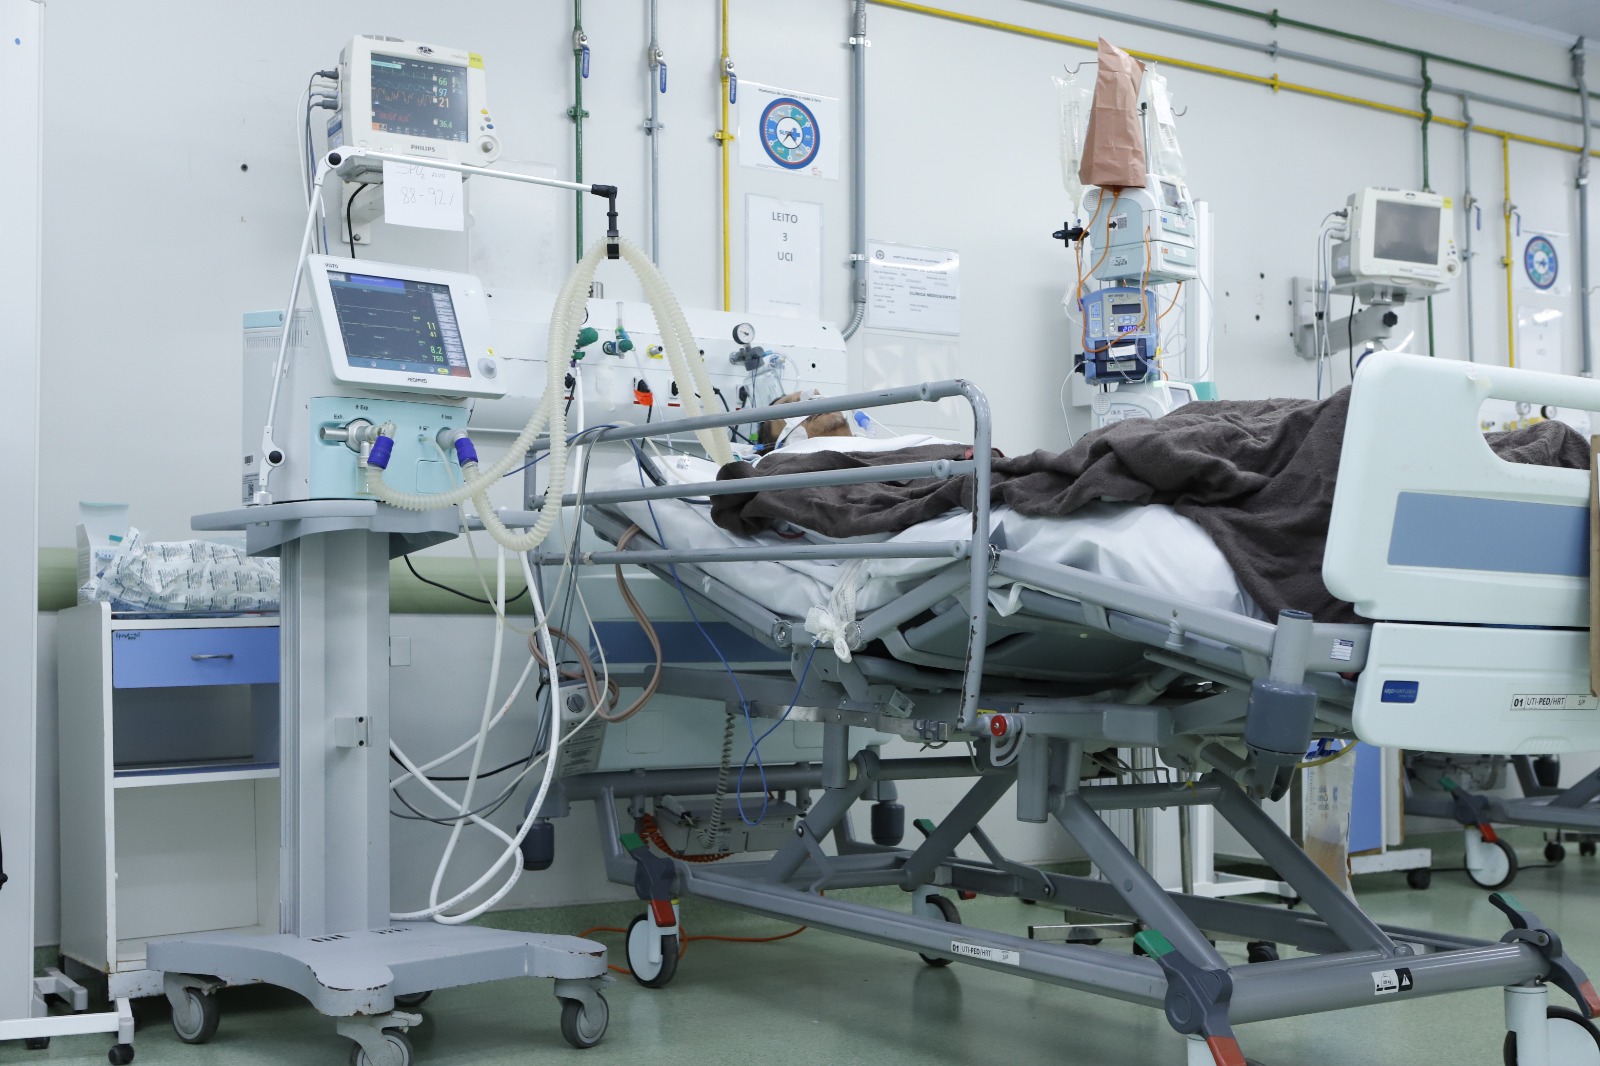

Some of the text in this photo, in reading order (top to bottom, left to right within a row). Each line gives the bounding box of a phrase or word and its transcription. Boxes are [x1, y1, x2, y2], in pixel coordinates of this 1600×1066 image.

[438, 78, 448, 86] 66
[438, 88, 448, 97] 97
[438, 97, 449, 108] 21
[410, 144, 436, 152] PHILIPS
[772, 211, 798, 224] LEITO
[782, 232, 788, 242] 3
[777, 251, 793, 262] UCI
[1513, 698, 1524, 707] 01
[1526, 697, 1565, 706] UTI-PED/HRT
[952, 944, 959, 952] 01
[961, 945, 991, 957] UTI-PED/HRT
